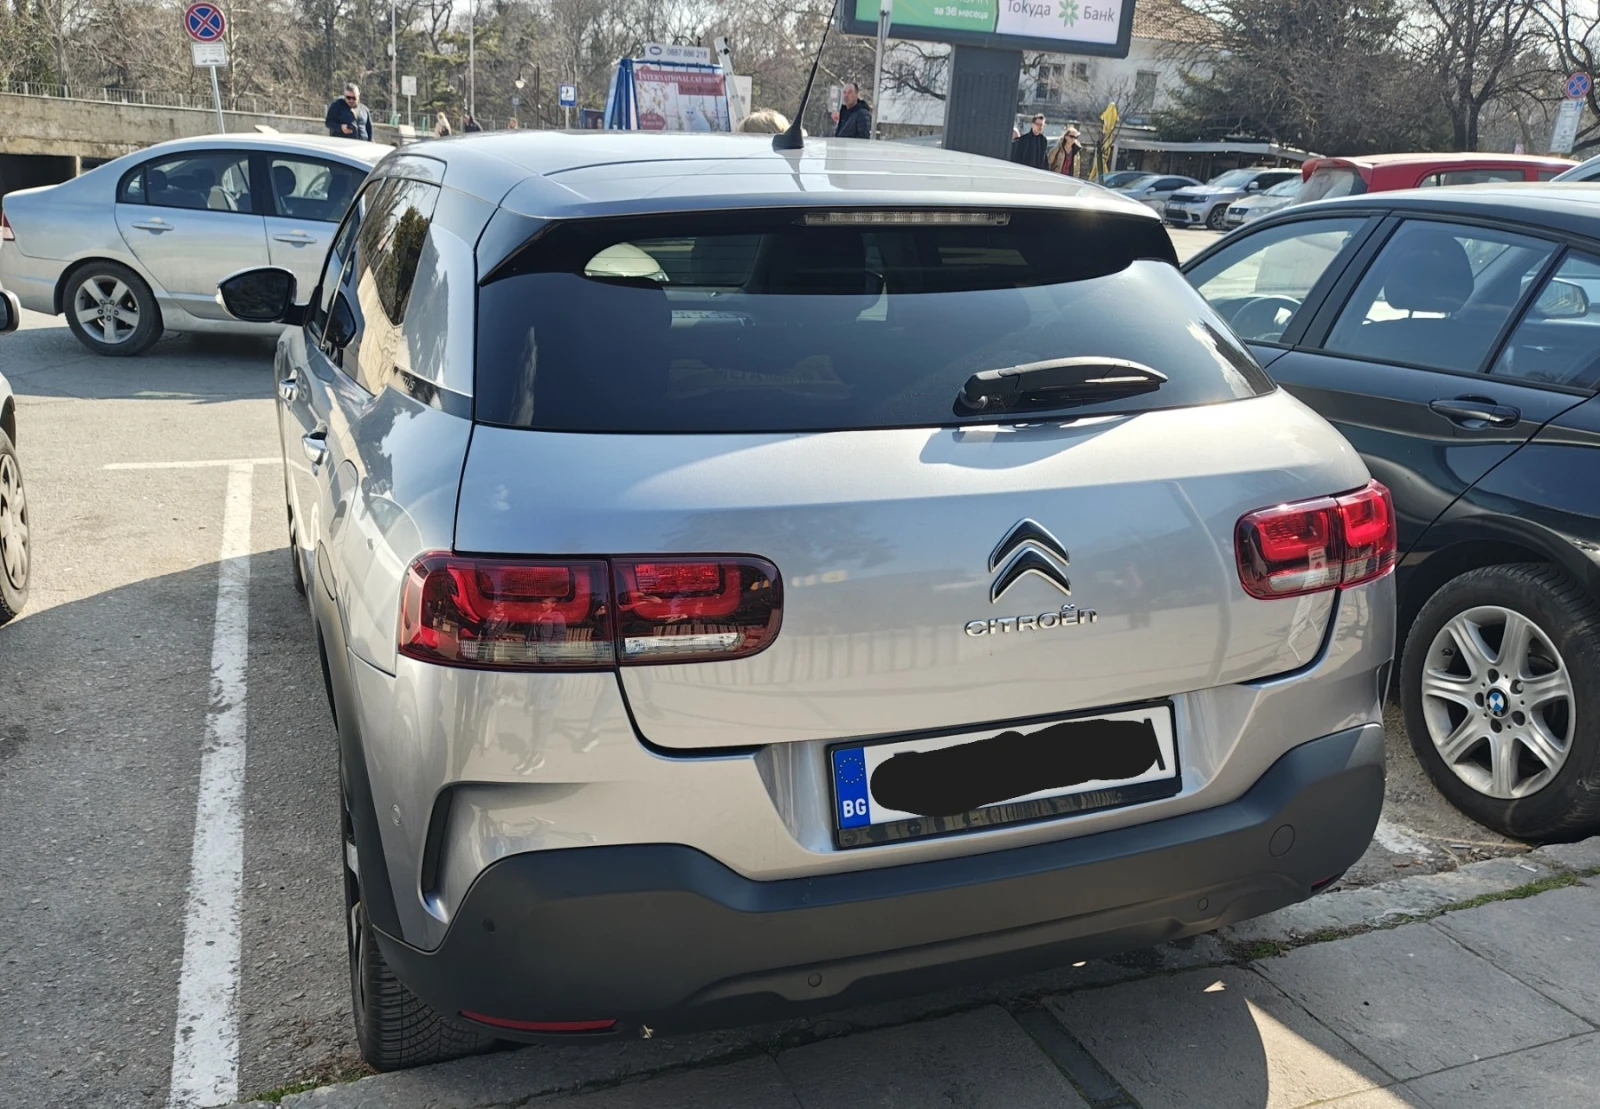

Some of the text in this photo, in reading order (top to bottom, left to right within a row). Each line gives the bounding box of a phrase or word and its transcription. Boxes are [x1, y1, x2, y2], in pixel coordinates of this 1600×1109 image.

[934, 7, 944, 16] за
[958, 9, 989, 20] месеца
[1007, 0, 1115, 22] Токуда Банк
[964, 603, 1098, 637] CITROËN
[842, 797, 867, 818] BG
